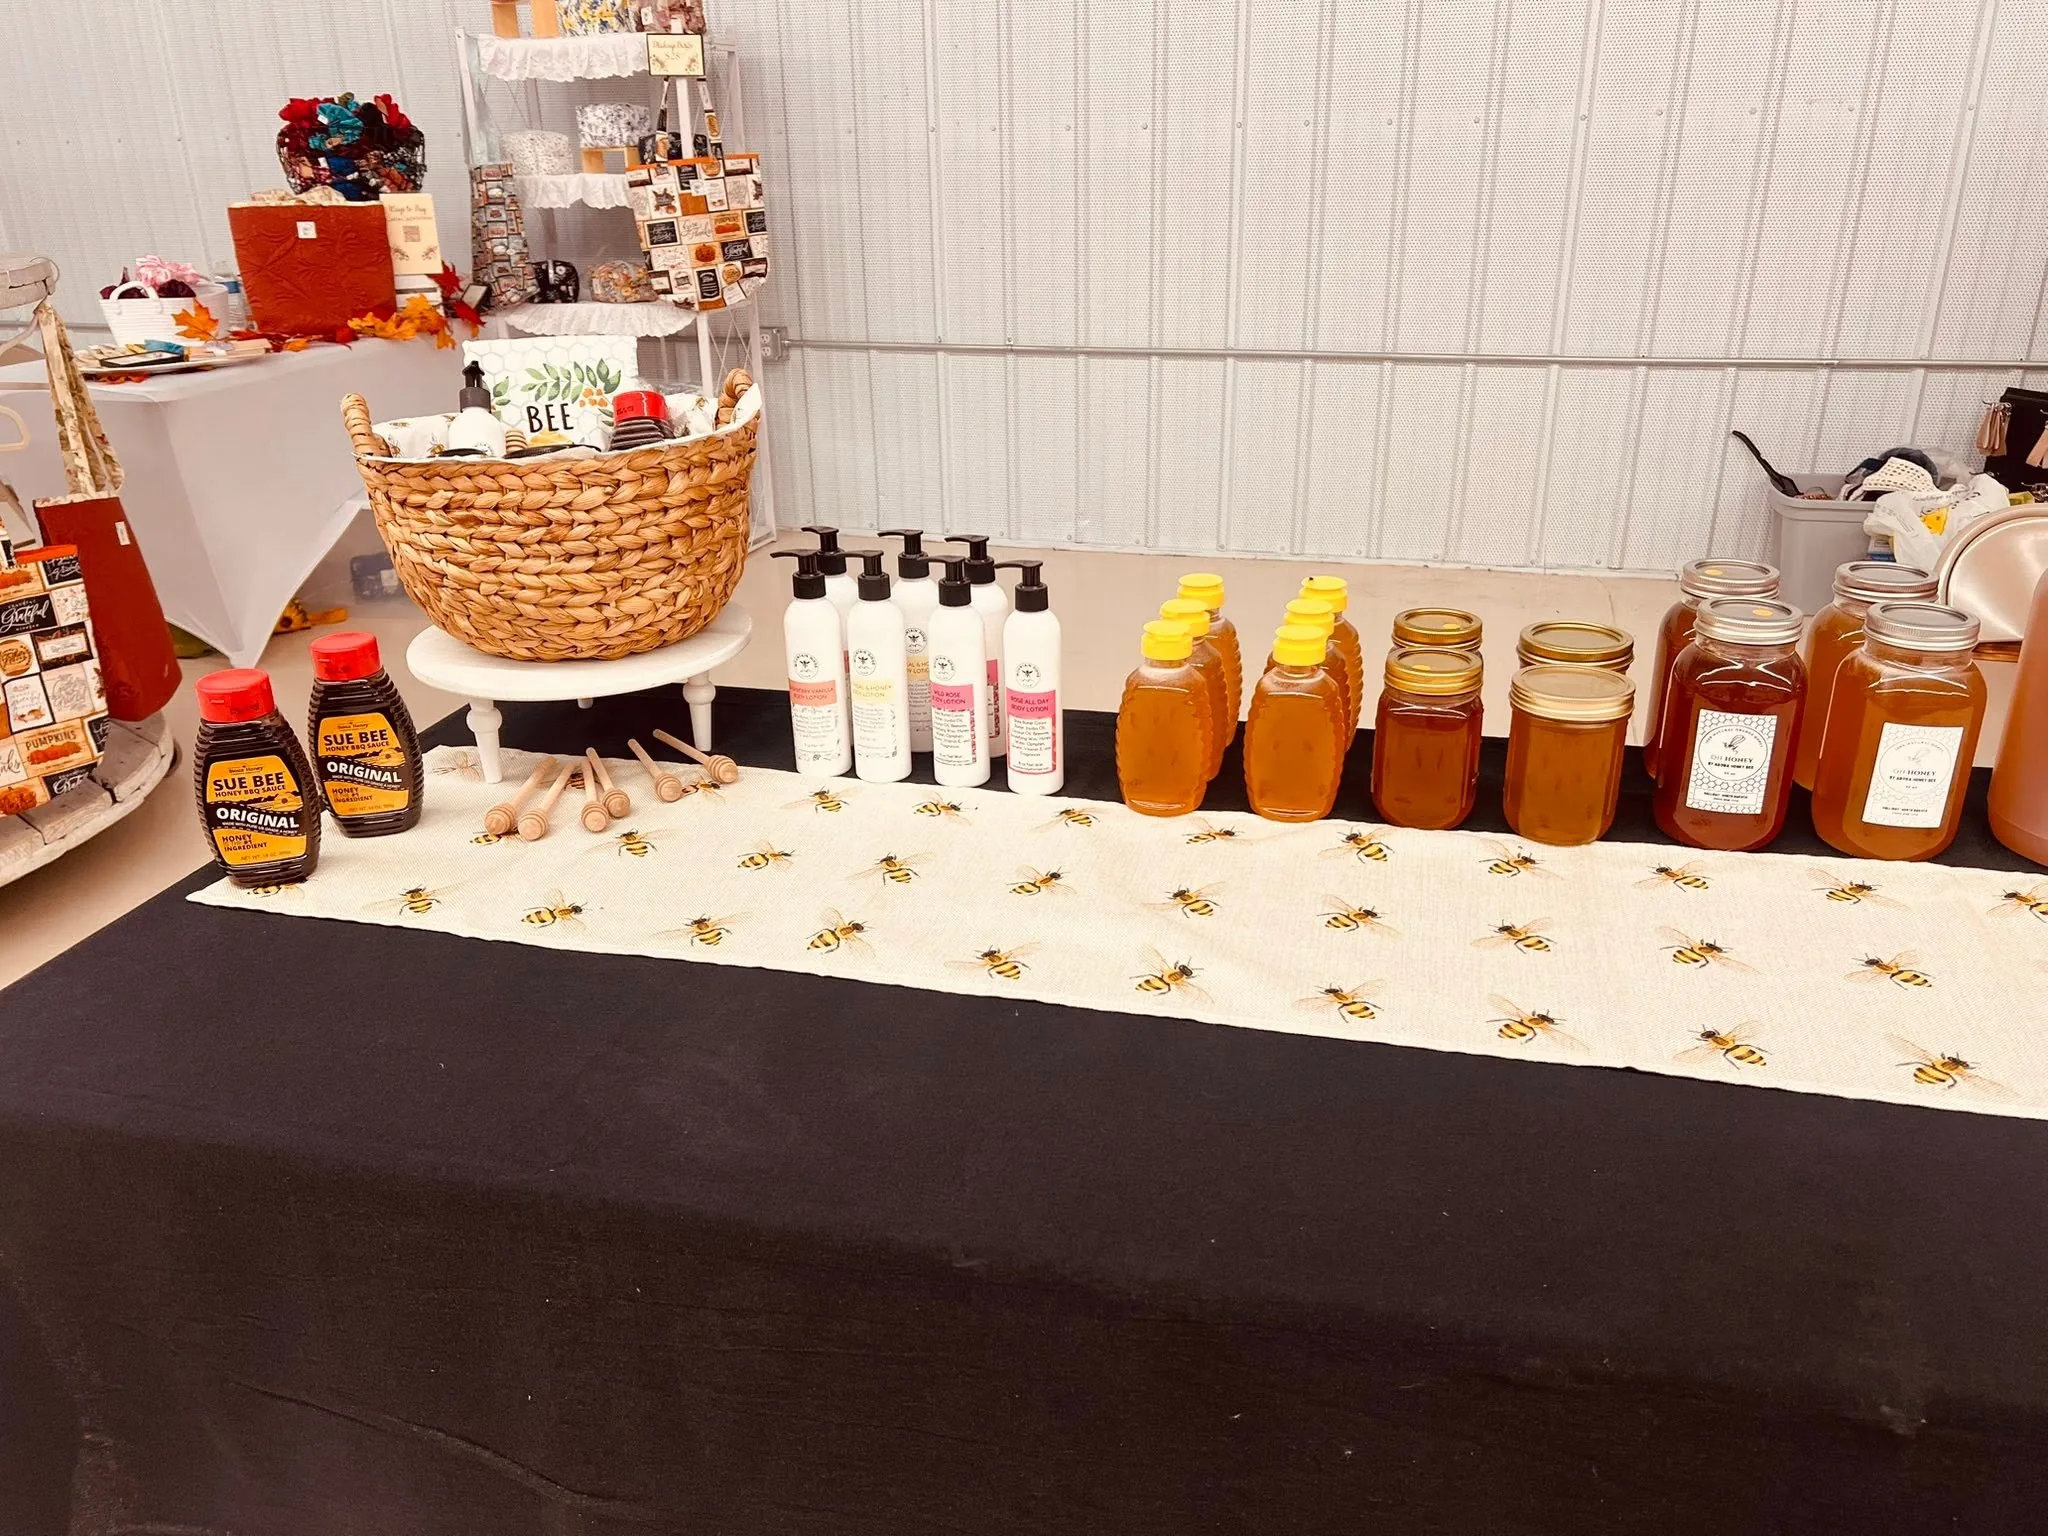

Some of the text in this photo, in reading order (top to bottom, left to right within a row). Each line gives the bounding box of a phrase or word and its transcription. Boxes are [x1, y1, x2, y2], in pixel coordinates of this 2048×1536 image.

[526, 403, 574, 433] BEE
[1011, 703, 1025, 711] BODY
[25, 730, 76, 751] PUMPKINS
[323, 729, 388, 746] SUE BEE
[367, 741, 390, 749] SAUCE
[326, 761, 402, 783] ORIGINAL
[213, 772, 284, 791] SUE BEE
[215, 790, 242, 798] HONEY
[216, 807, 299, 829] ORIGINAL
[222, 834, 252, 842] HONEY
[224, 842, 268, 852] INGREDIENT
